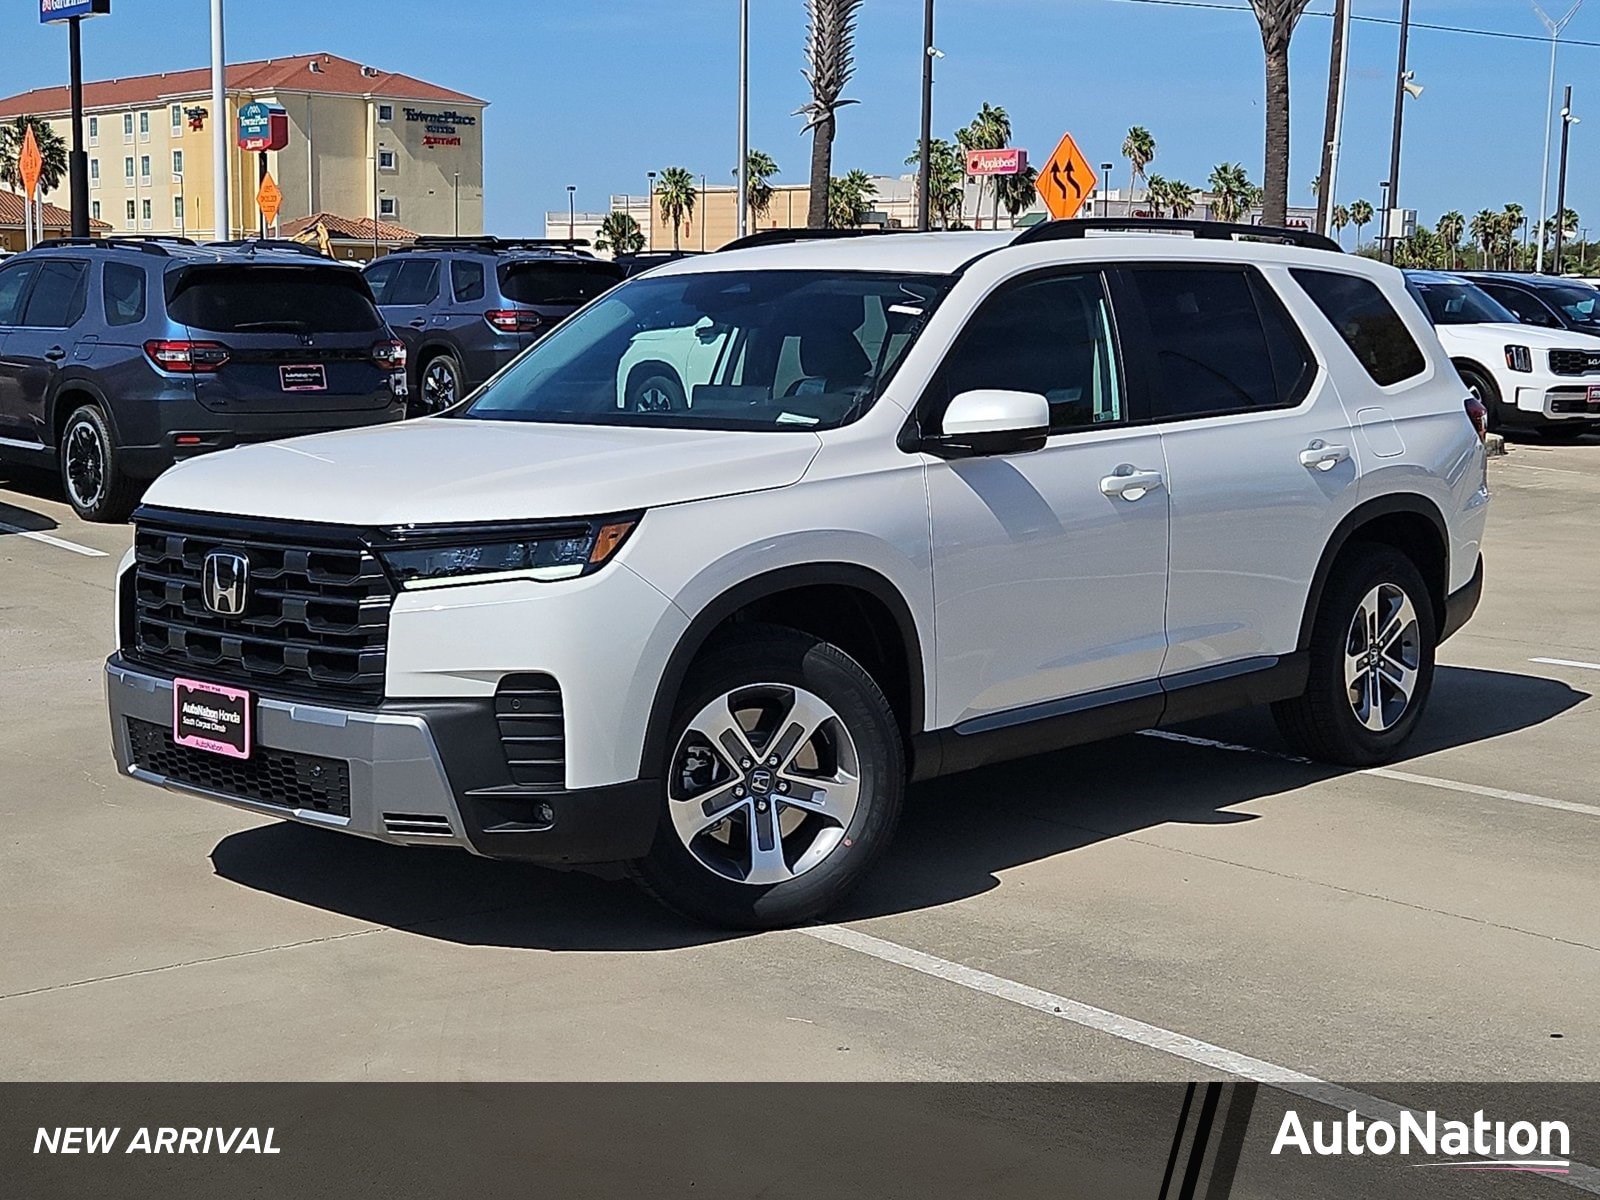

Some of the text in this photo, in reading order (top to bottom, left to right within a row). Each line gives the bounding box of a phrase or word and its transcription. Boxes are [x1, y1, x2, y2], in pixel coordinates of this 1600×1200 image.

[402, 107, 476, 125] TownePlace
[182, 702, 241, 724] AutoNation Honda
